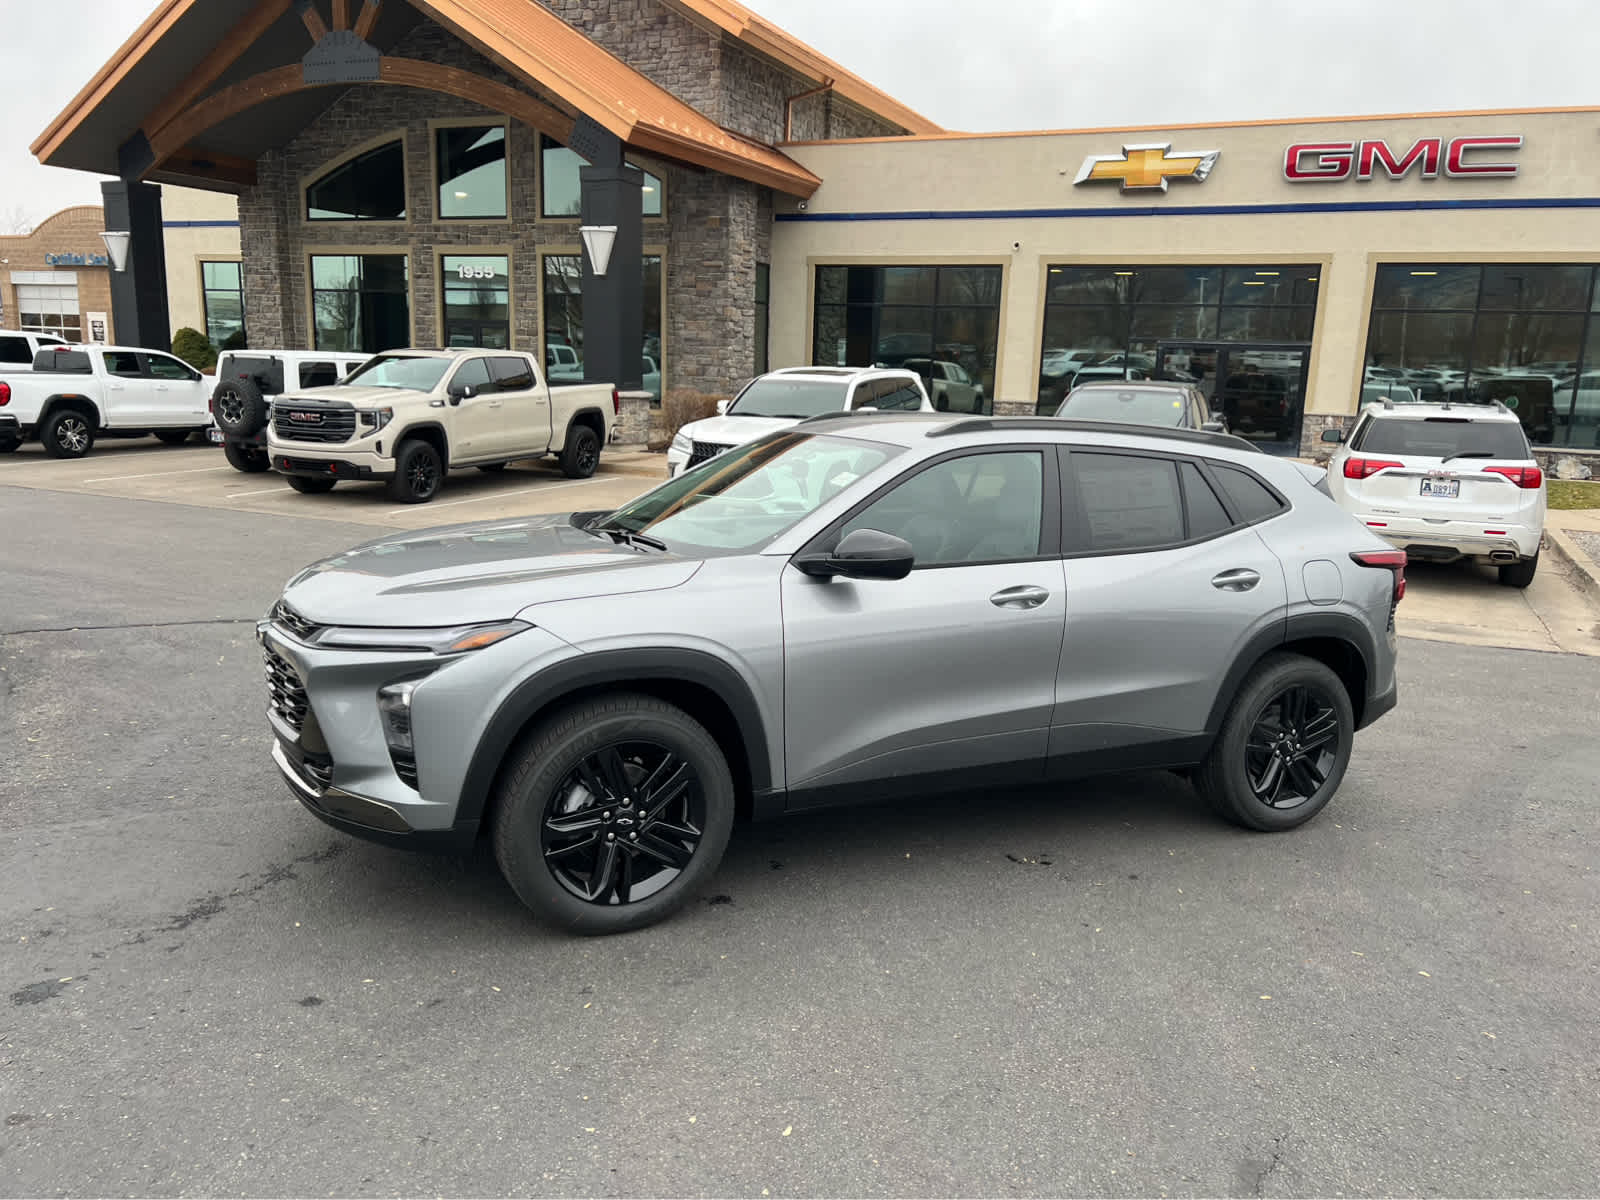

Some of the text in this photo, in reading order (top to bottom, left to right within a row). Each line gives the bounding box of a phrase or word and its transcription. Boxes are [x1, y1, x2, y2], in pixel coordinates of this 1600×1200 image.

[1284, 135, 1523, 182] GMC
[45, 252, 86, 265] Certified
[457, 264, 495, 279] 1955
[290, 412, 320, 421] GMC
